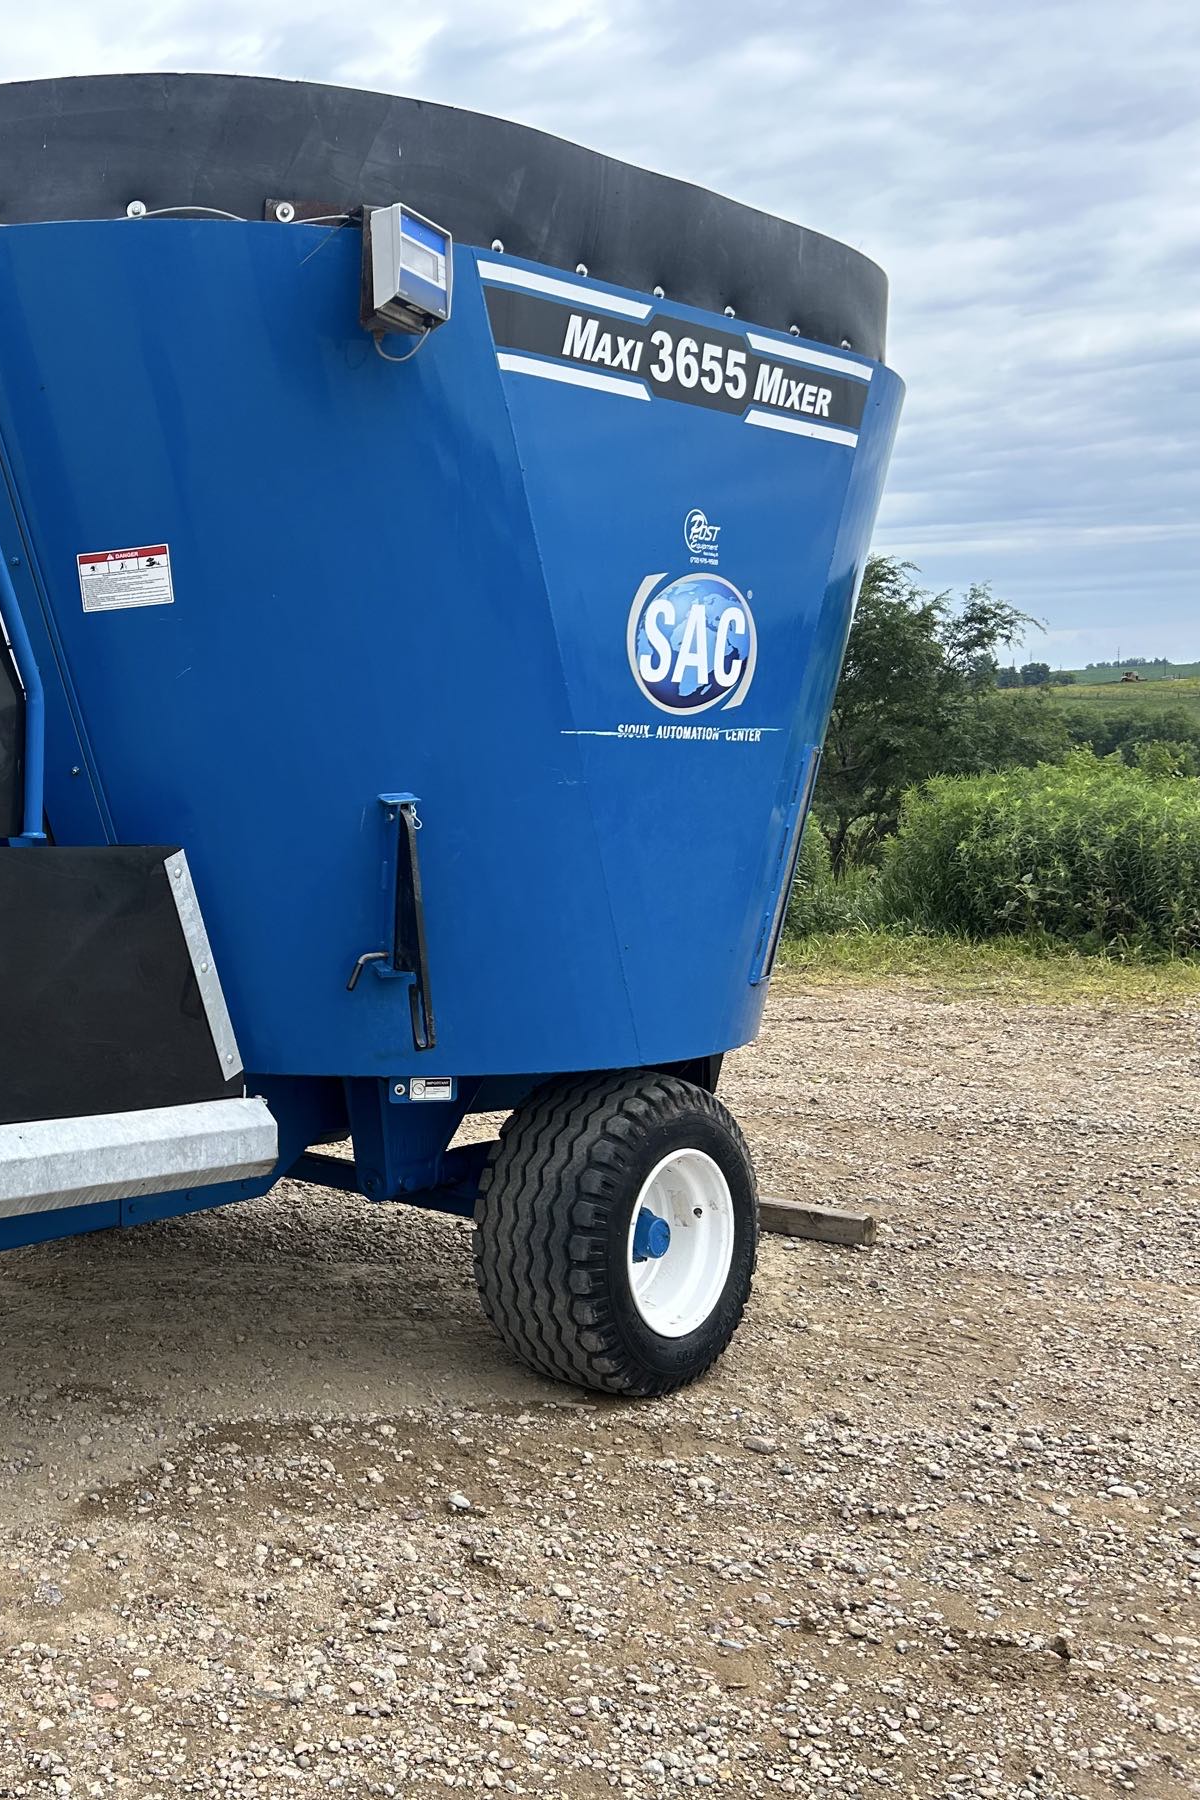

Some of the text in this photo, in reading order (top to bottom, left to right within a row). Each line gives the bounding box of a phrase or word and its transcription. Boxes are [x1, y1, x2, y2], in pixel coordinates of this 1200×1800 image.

[649, 330, 747, 399] 3655
[115, 551, 139, 559] DANGER
[640, 599, 745, 687] SAC
[617, 724, 761, 741] SIOUX AUTOMATION CENTER
